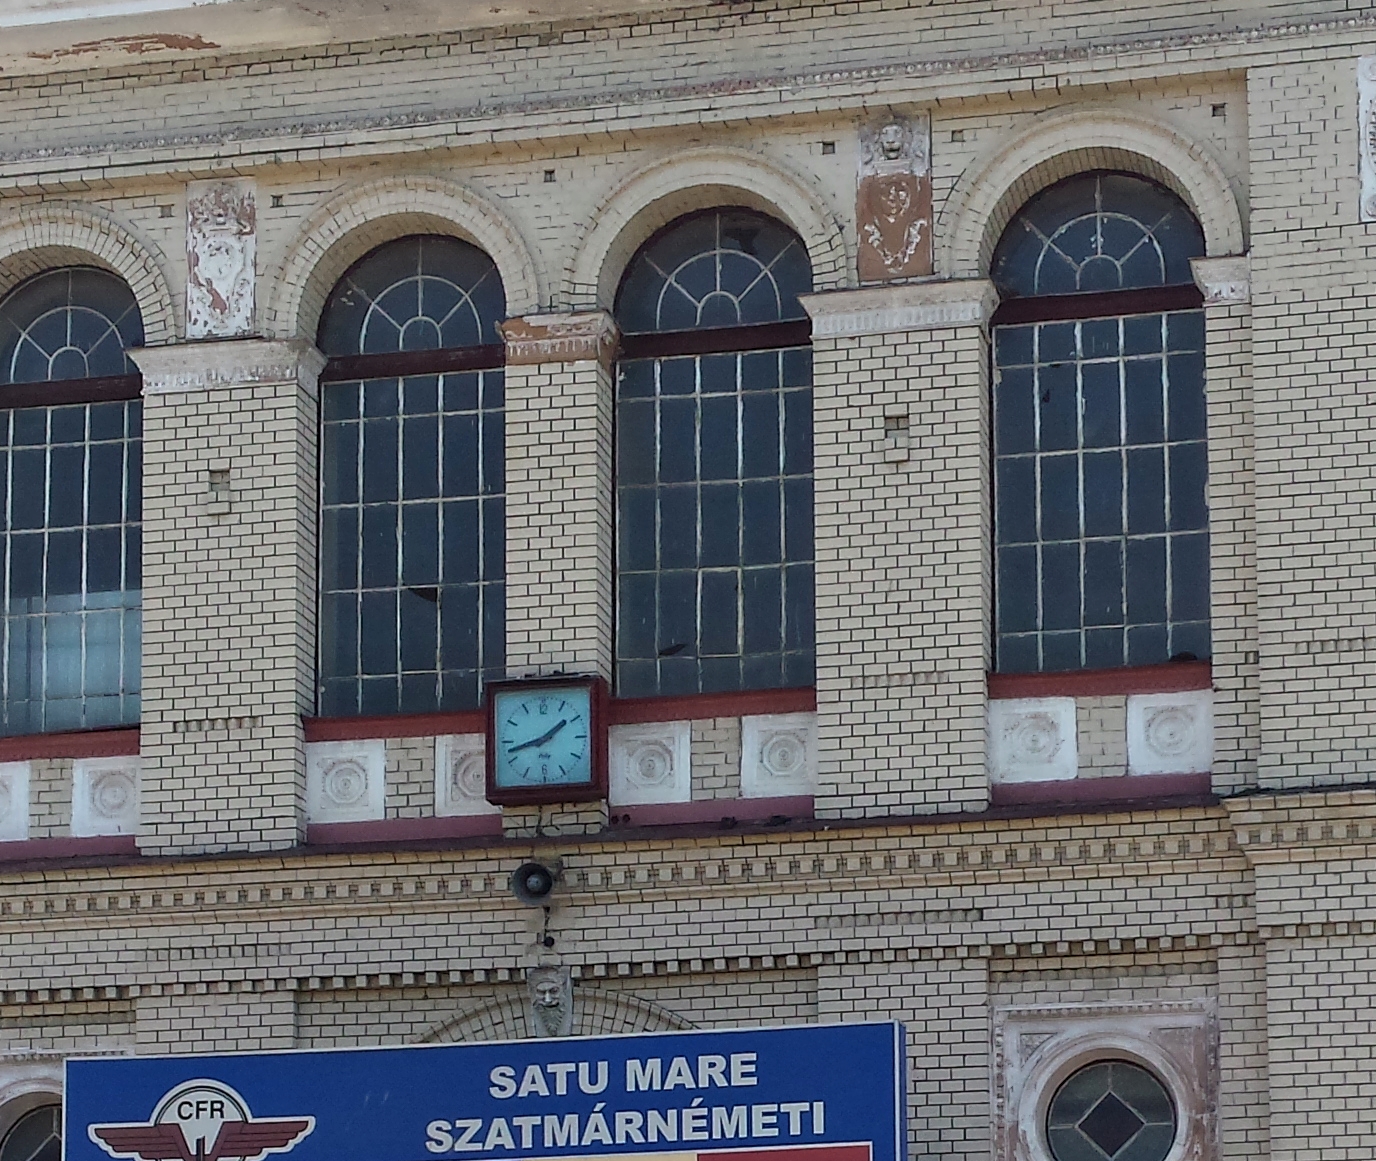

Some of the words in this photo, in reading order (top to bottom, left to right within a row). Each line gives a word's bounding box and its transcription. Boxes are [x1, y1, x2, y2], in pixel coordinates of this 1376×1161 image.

[489, 1060, 609, 1099] SATU
[625, 1053, 758, 1092] MARE
[177, 1100, 225, 1121] CFR
[425, 1098, 826, 1153] SZATMÁRNÉMETI
